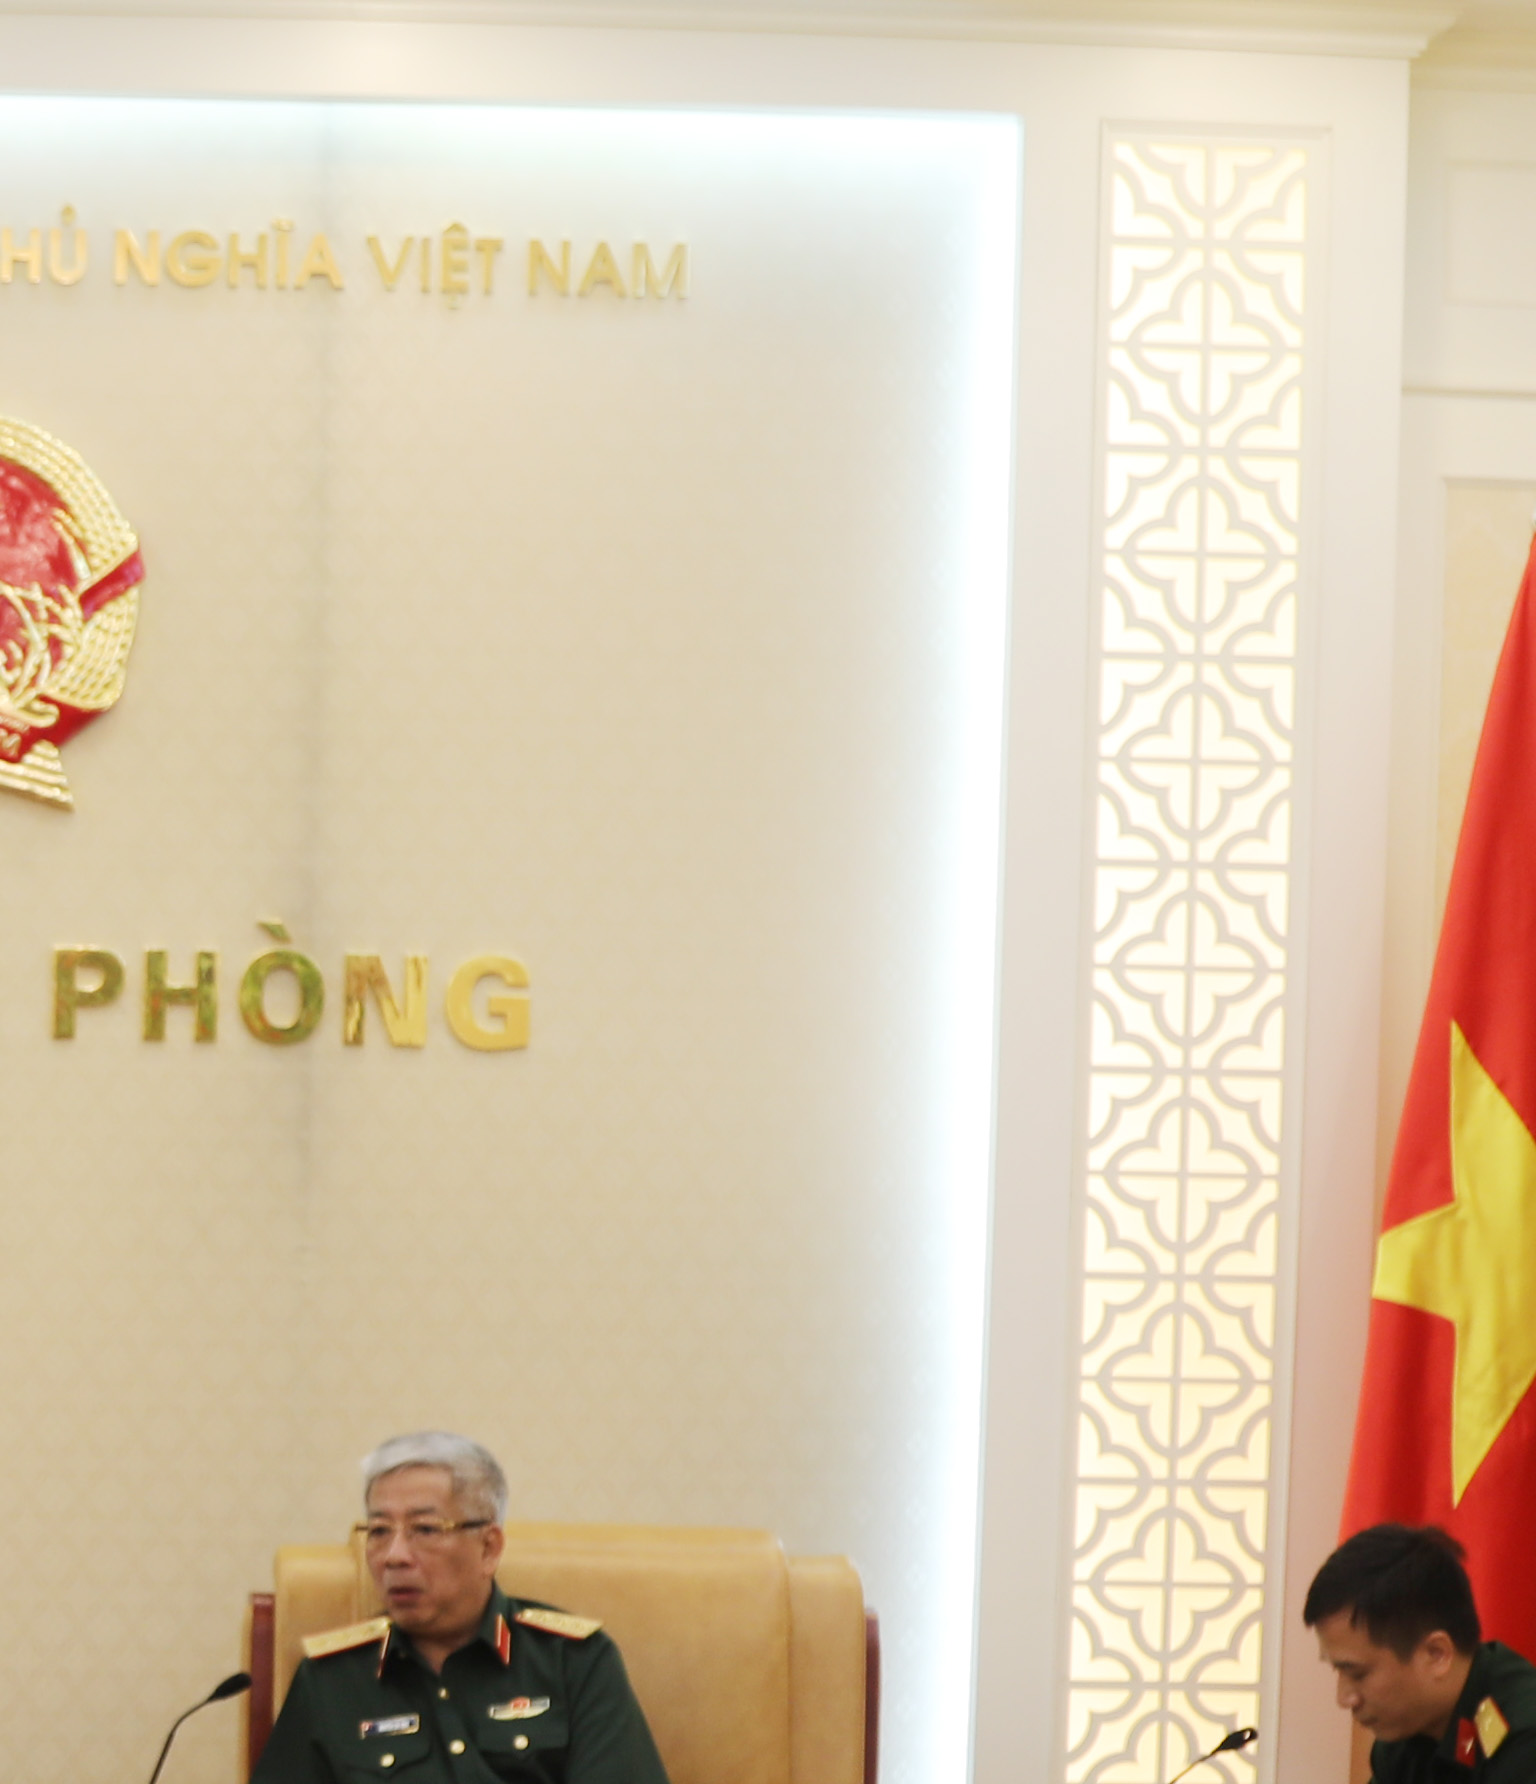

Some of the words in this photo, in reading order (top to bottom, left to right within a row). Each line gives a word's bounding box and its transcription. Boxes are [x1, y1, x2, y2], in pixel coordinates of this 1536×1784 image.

[113, 218, 344, 290] NGHĨA
[366, 221, 504, 310] VIỆT
[527, 239, 690, 299] NAM
[52, 918, 532, 1052] PHÒNG
